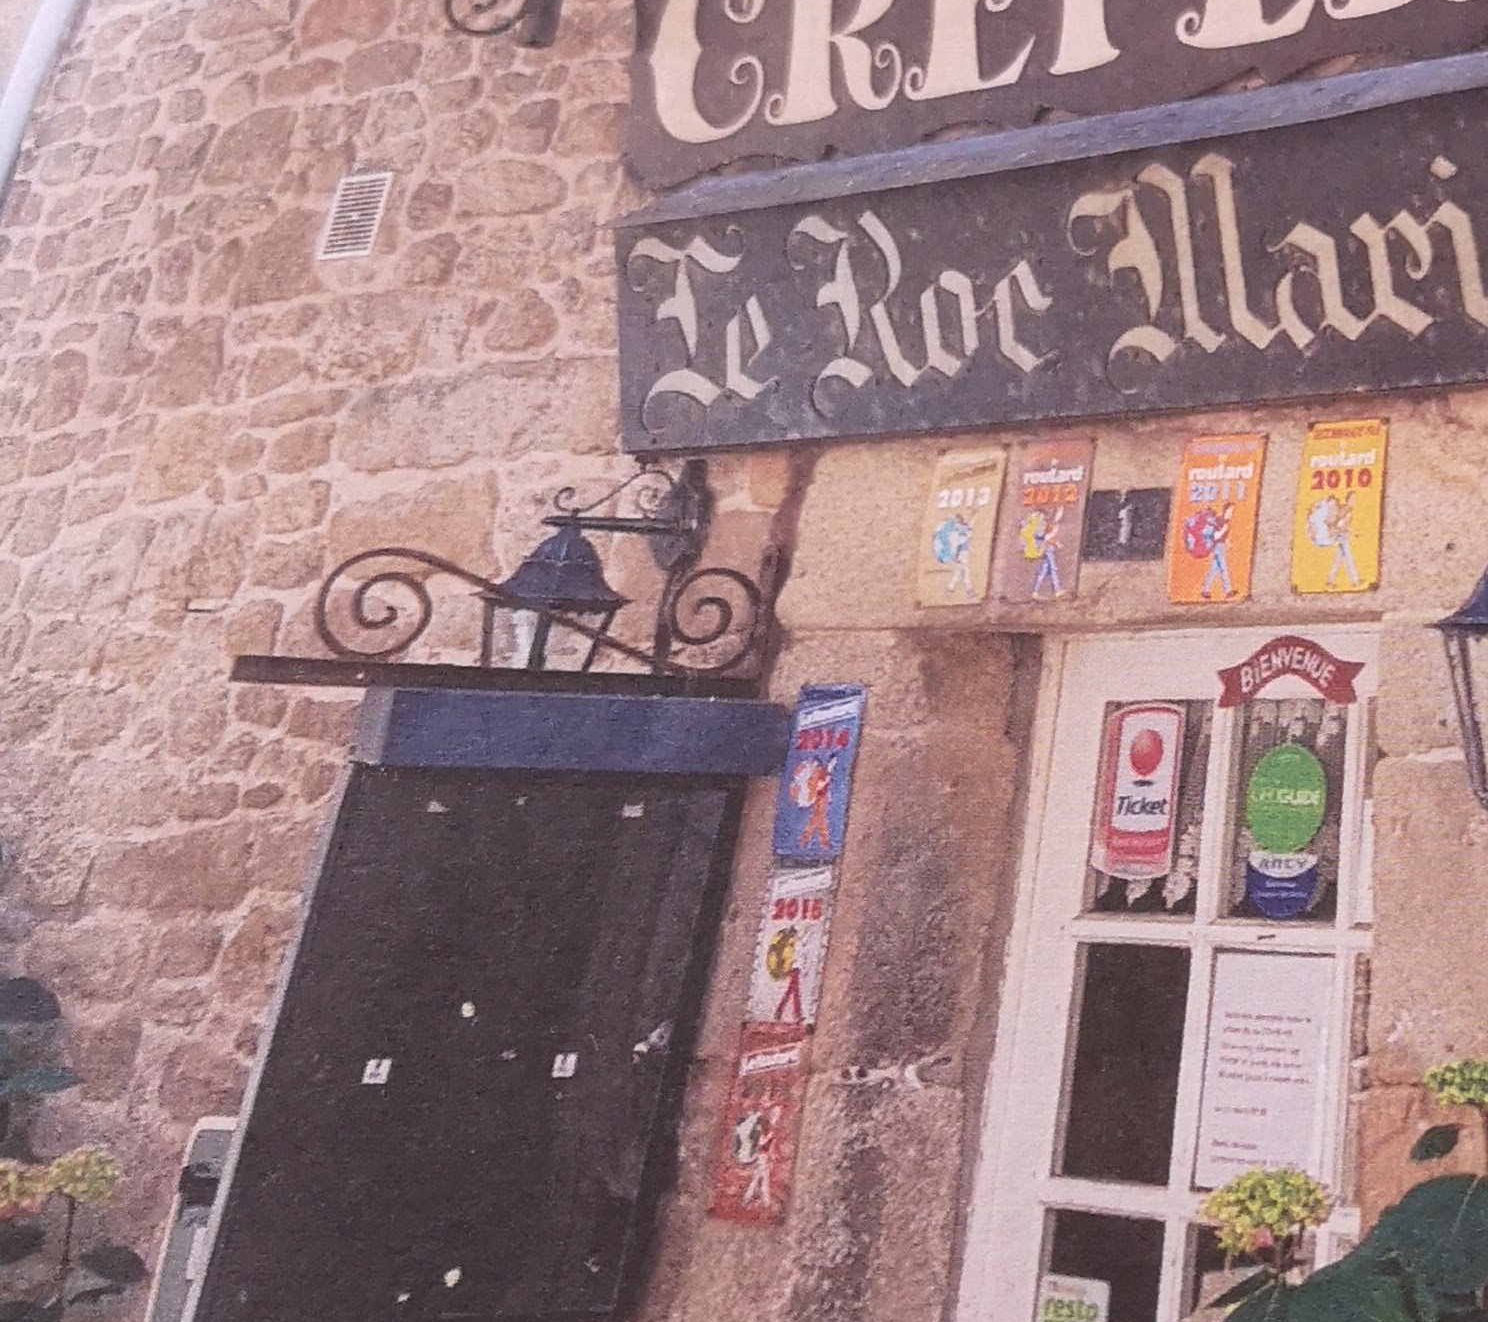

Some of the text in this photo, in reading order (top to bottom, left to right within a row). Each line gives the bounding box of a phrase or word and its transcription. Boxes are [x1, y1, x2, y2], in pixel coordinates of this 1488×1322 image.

[626, 230, 773, 435] Le
[787, 210, 1052, 427] Roc
[1311, 469, 1371, 489] 2010
[936, 486, 992, 509] 2013
[1022, 484, 1078, 506] 2012
[1190, 481, 1246, 502] 2011
[1240, 646, 1336, 693] BIENVENUE
[1116, 794, 1168, 816] Ticket
[772, 898, 824, 920] 2015
